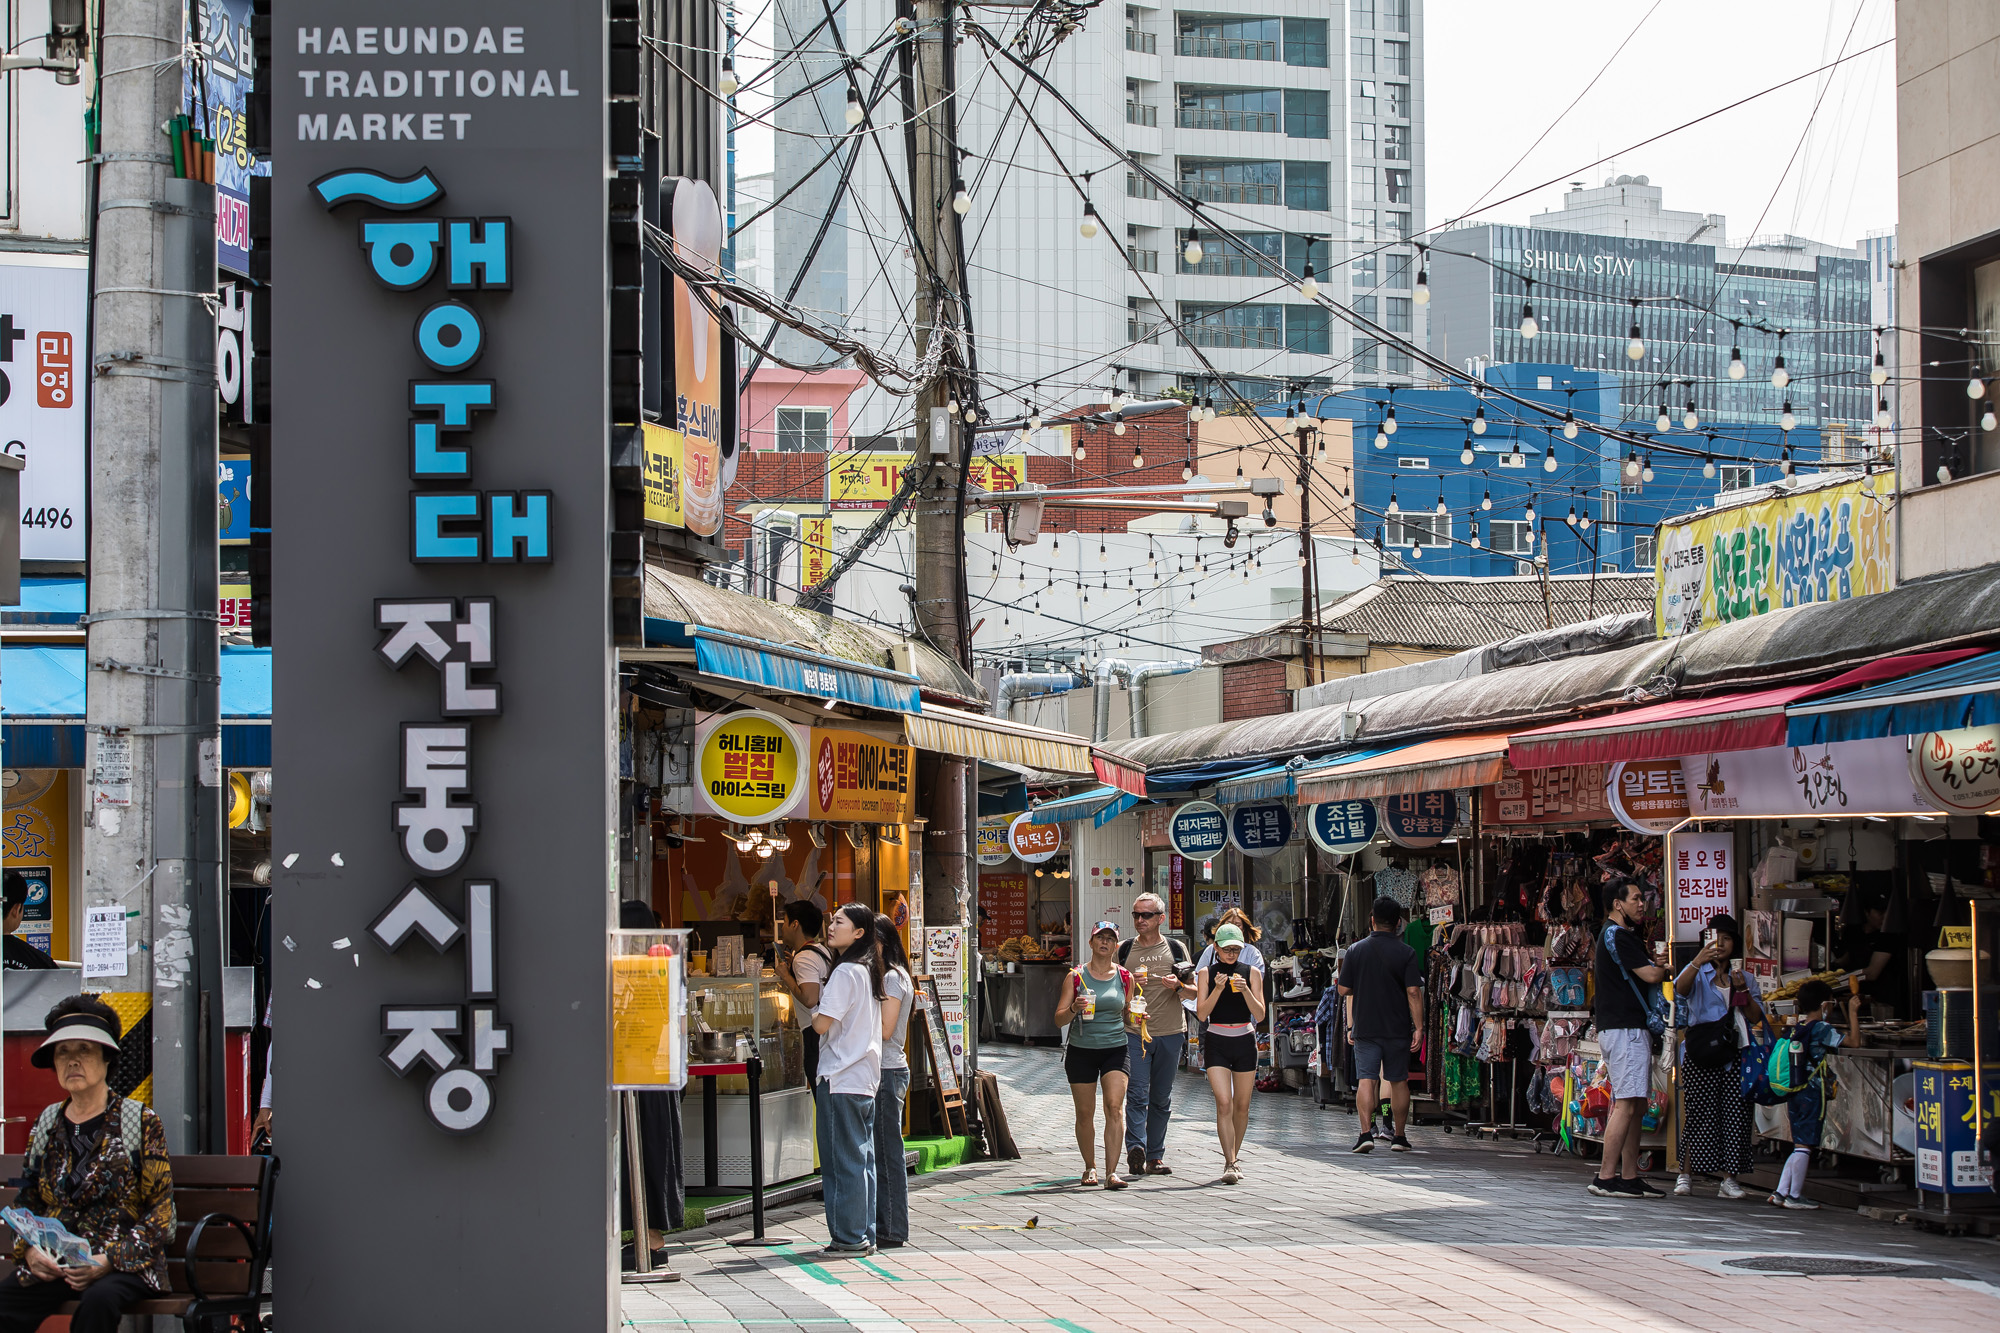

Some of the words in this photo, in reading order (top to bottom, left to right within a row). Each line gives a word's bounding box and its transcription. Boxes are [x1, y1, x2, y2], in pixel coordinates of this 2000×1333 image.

[298, 27, 525, 54] HAEUNDAE
[298, 70, 579, 97] TRADITIONAL
[298, 113, 471, 140] MARKET
[1523, 249, 1586, 273] SHILLA
[1593, 255, 1635, 276] STAY
[308, 166, 553, 563] 해운대
[693, 452, 709, 489] 2F
[22, 507, 73, 529] 4496
[718, 734, 782, 753] 허니홈비
[724, 752, 775, 781] 벌집
[711, 780, 786, 799] 아이스크림
[1178, 816, 1221, 832] 돼지국밥
[1244, 810, 1279, 827] 과일
[1401, 818, 1443, 833] 양품점
[1179, 832, 1223, 848] 할매김밥
[1328, 820, 1366, 840] 신발
[365, 597, 512, 1133] 전통시장
[1678, 877, 1728, 898] 원조김밥
[1949, 1076, 1973, 1090] 수제
[1918, 1101, 1941, 1142] 식혜
